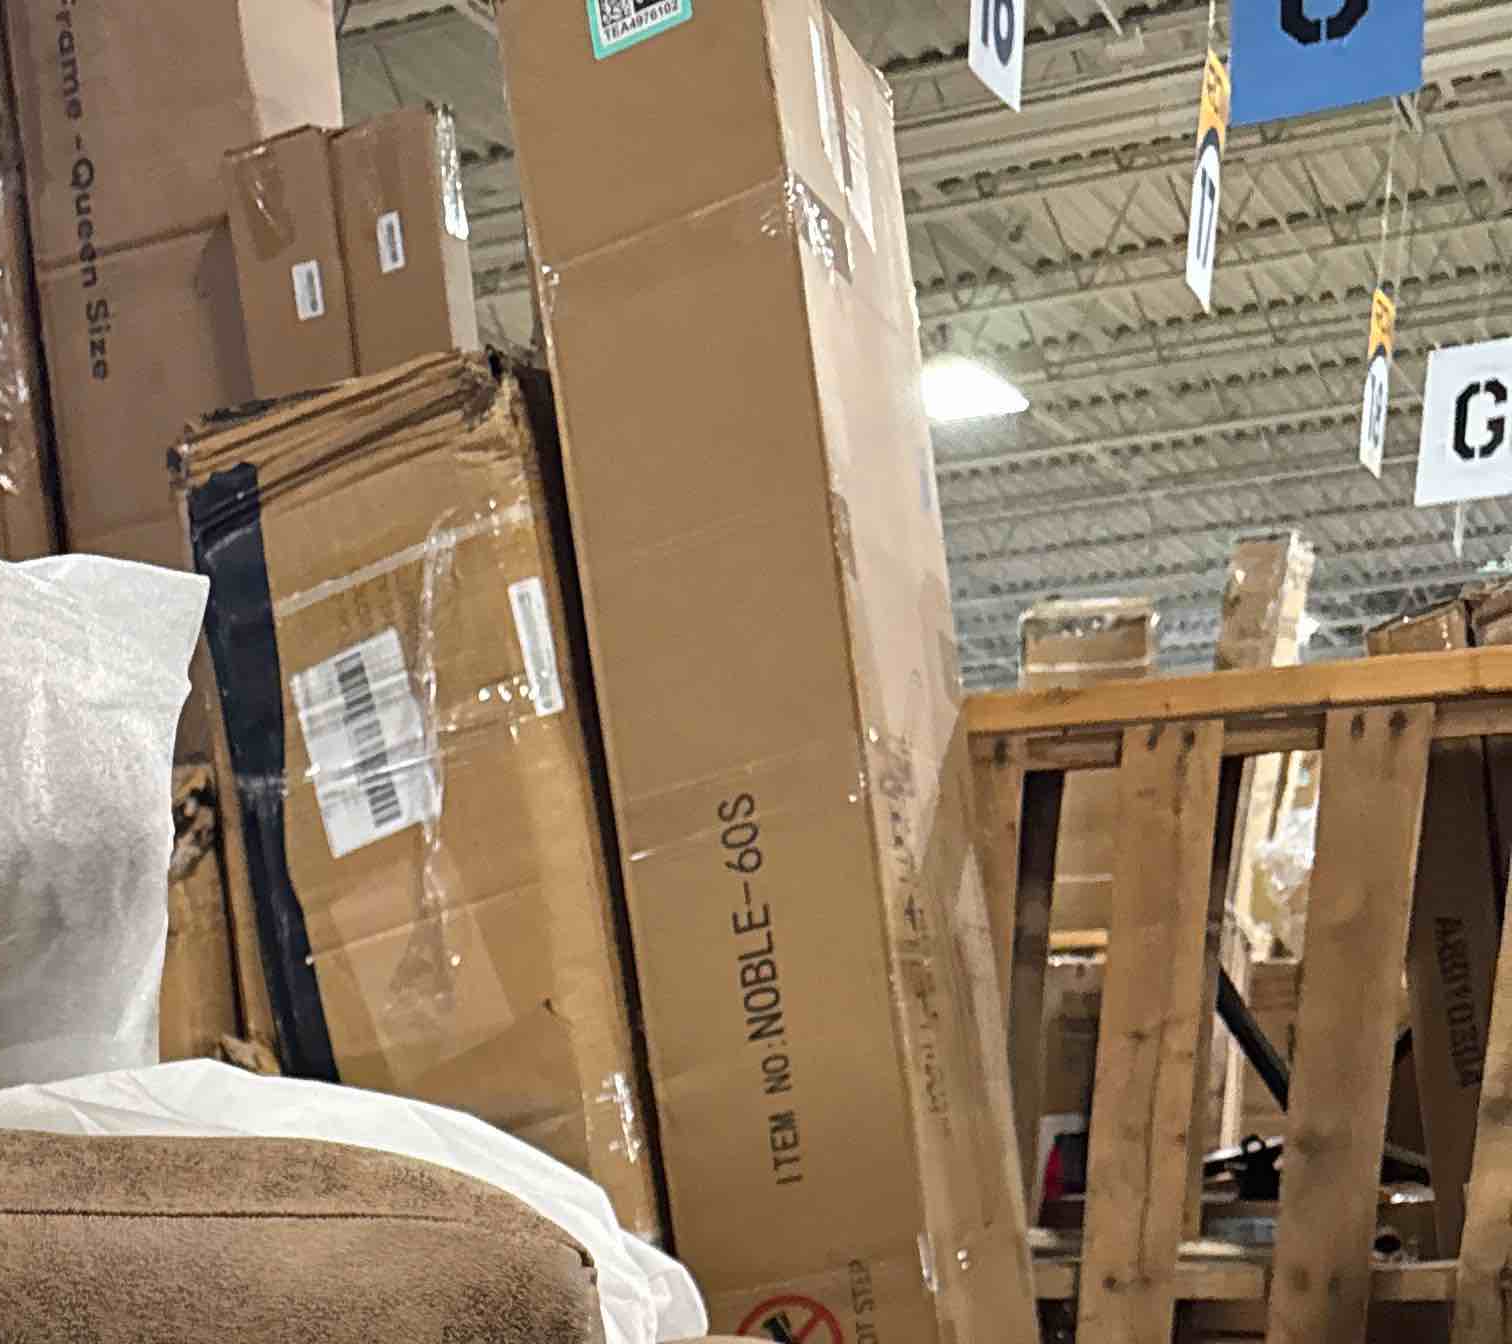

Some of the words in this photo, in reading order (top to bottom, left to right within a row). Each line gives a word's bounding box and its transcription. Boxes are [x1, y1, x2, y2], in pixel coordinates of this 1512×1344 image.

[55, 0, 82, 121] rame
[71, 157, 98, 288] Queen
[85, 299, 111, 380] Size
[1196, 167, 1216, 269] 17
[1453, 377, 1508, 461] G
[768, 1108, 804, 1186] ITEM
